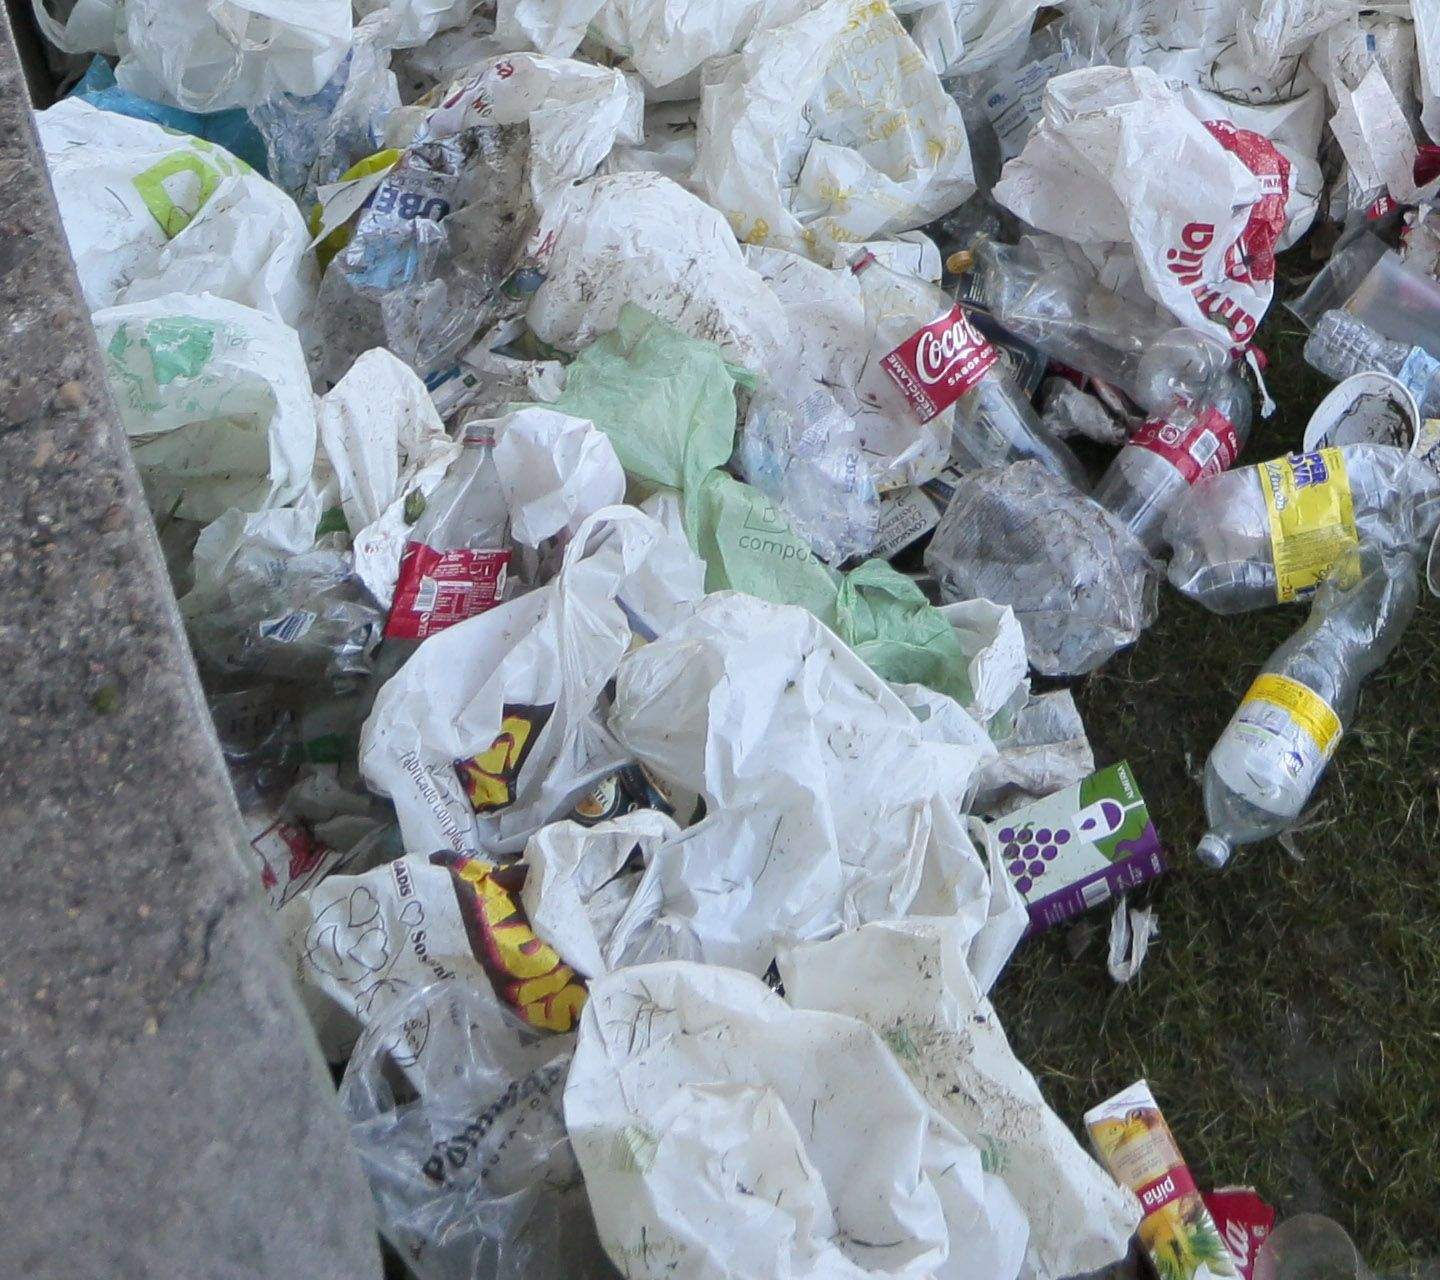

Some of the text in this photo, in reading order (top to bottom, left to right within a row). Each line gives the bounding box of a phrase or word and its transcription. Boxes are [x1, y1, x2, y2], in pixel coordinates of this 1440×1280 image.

[1167, 222, 1255, 342] amilia
[884, 354, 937, 422] RECICLAME
[946, 356, 981, 387] SABOR
[1143, 1175, 1175, 1205] piña
